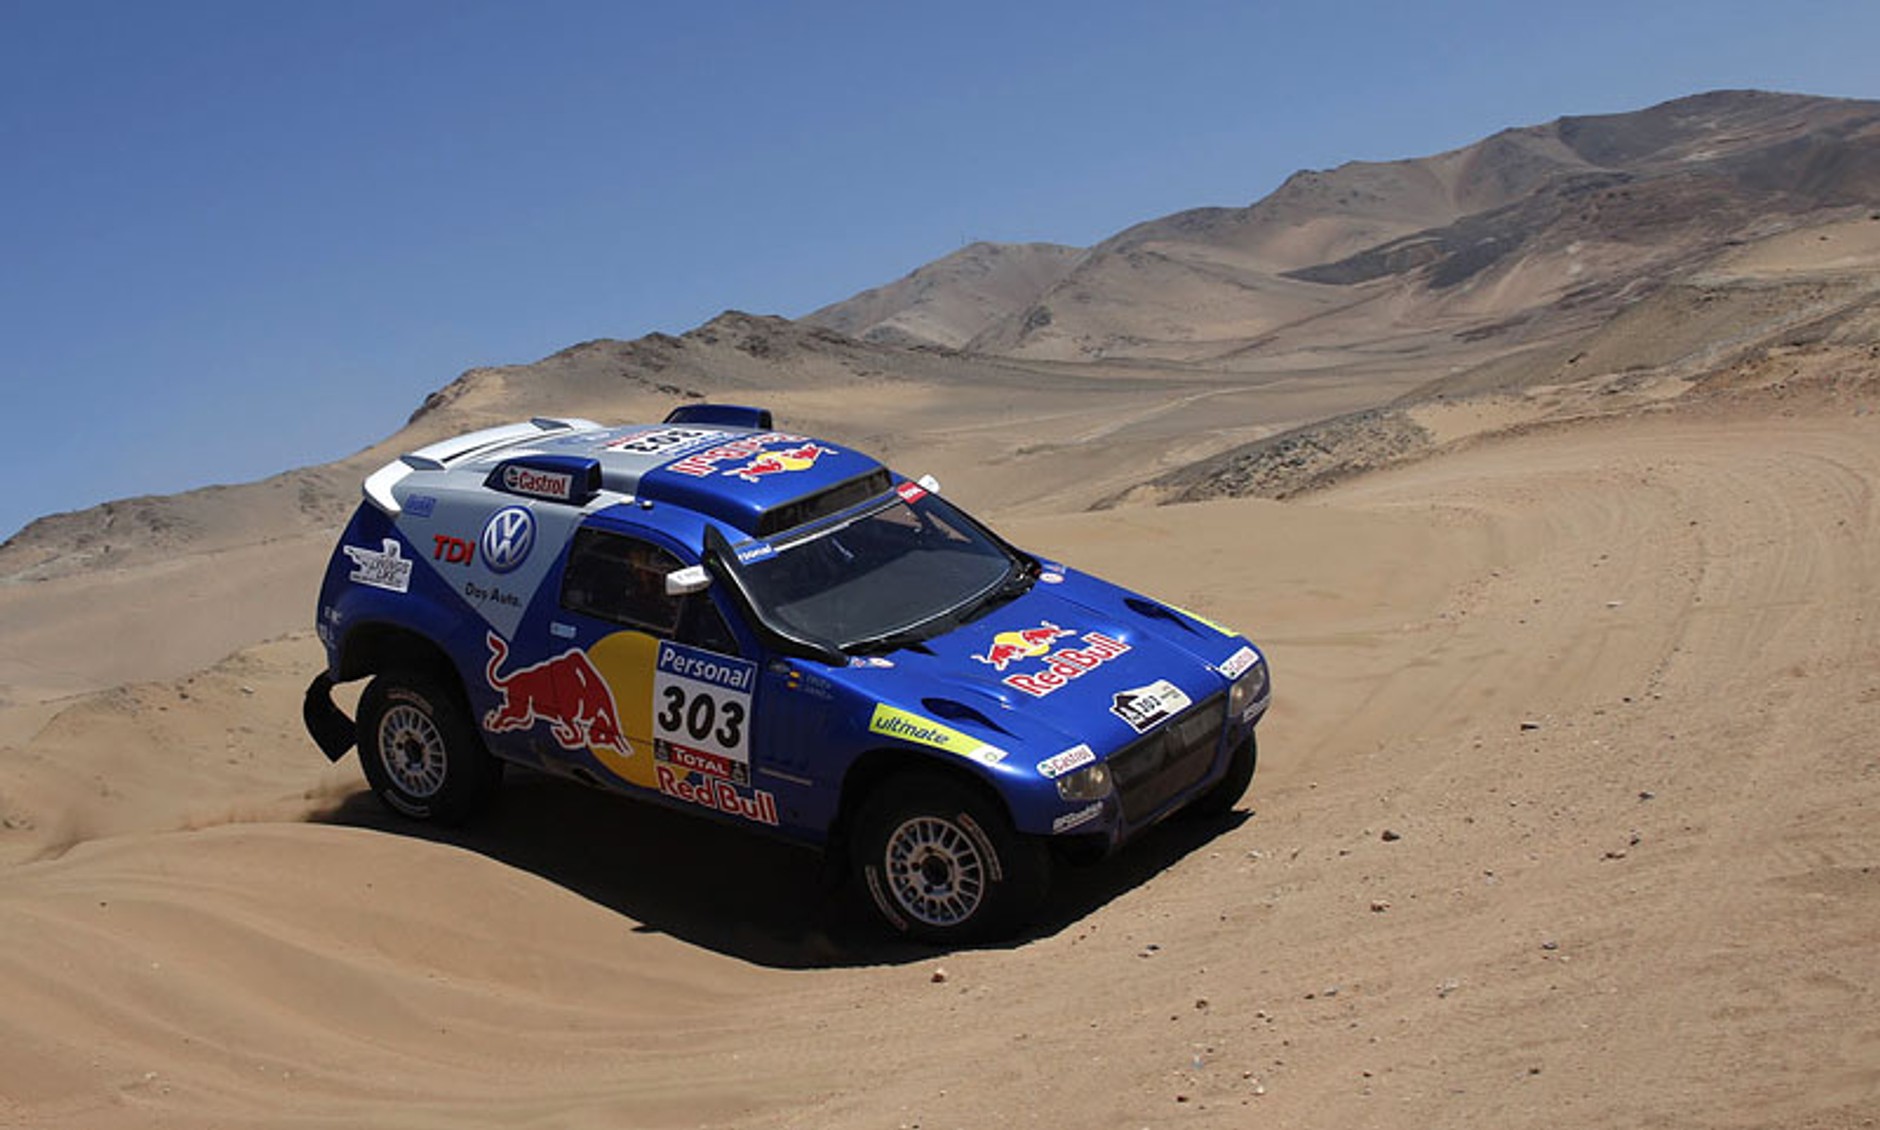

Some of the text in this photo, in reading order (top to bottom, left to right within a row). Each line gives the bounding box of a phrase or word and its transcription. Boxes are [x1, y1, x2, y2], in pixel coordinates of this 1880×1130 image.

[519, 471, 566, 495] Castrol
[432, 534, 476, 567] TDI
[464, 582, 488, 597] Das
[660, 649, 750, 689] Personal
[1003, 632, 1132, 697] Red Bull
[658, 685, 745, 749] 303
[1134, 694, 1162, 713] 303
[876, 716, 949, 745] ultimate
[672, 747, 731, 776] TOTAL
[656, 764, 718, 809] Red
[716, 781, 779, 825] Bull
